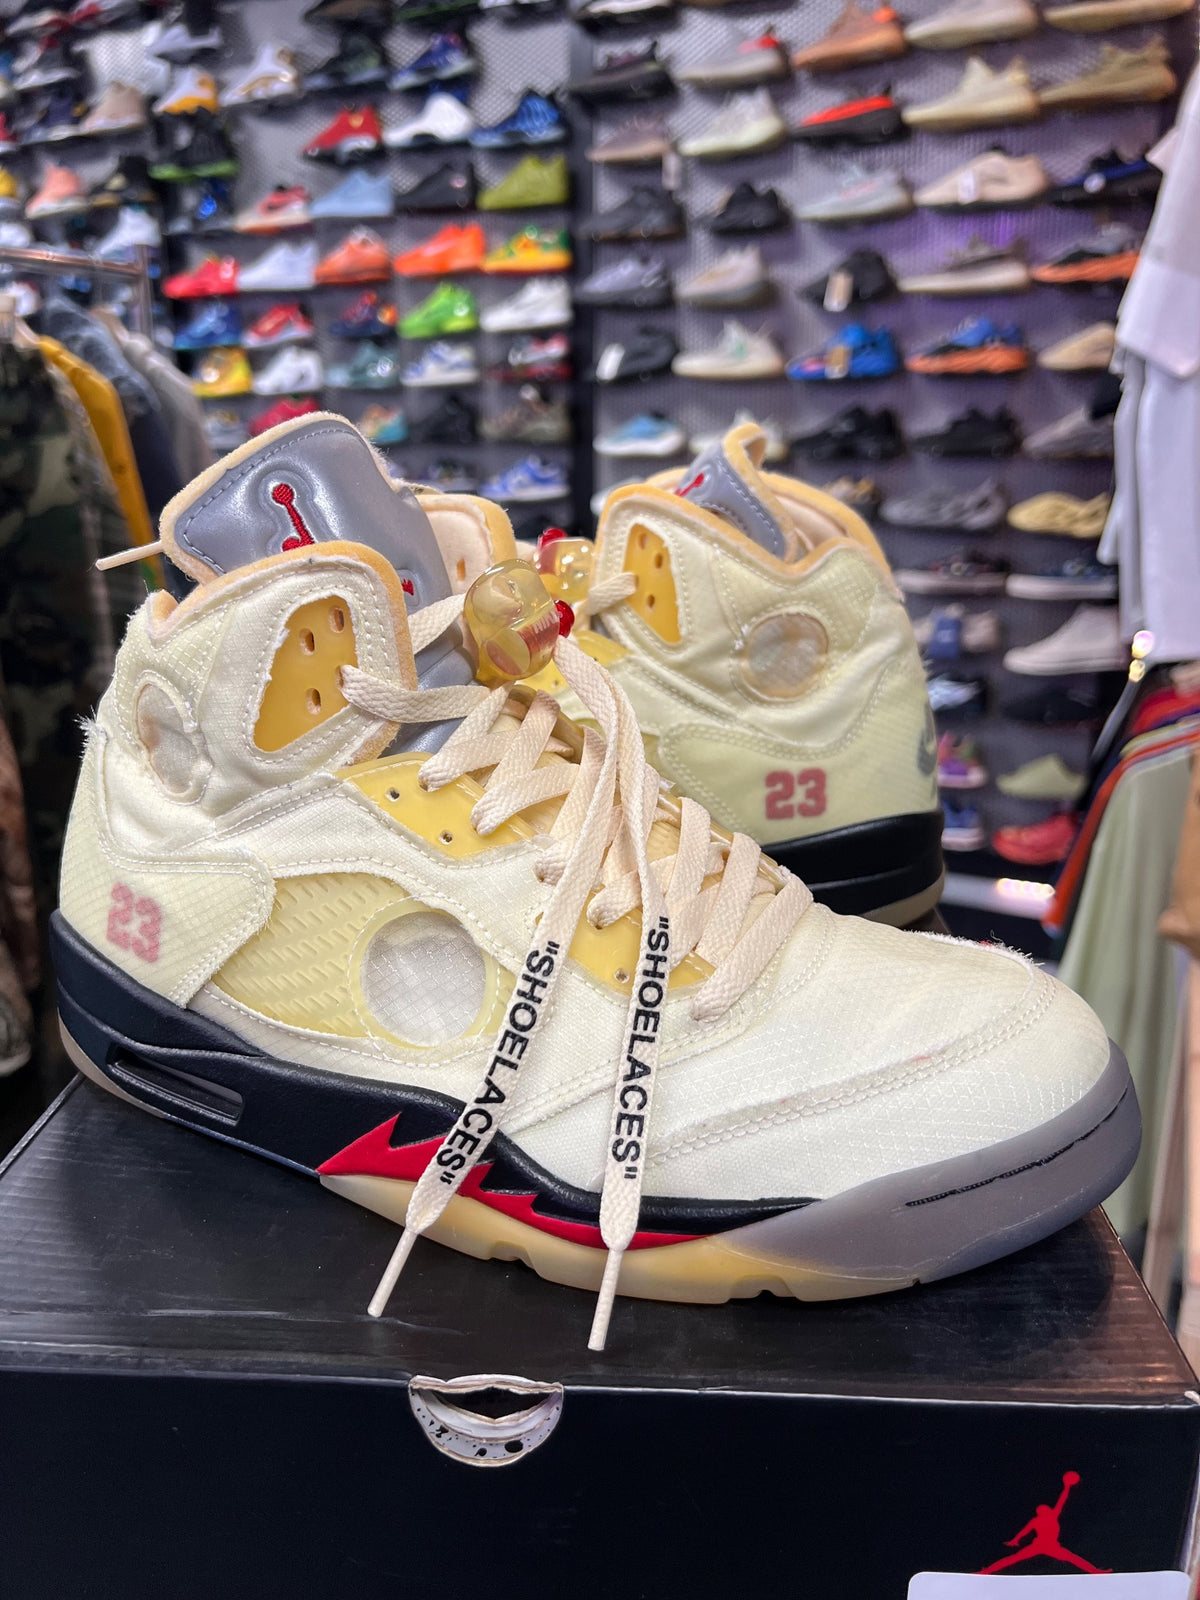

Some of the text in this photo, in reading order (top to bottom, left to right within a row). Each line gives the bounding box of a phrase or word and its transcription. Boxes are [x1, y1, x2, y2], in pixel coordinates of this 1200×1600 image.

[765, 767, 827, 821] 23
[106, 882, 162, 963] 23
[436, 941, 560, 1184] "SHOELACES"
[612, 917, 669, 1179] "SHOELACES"
